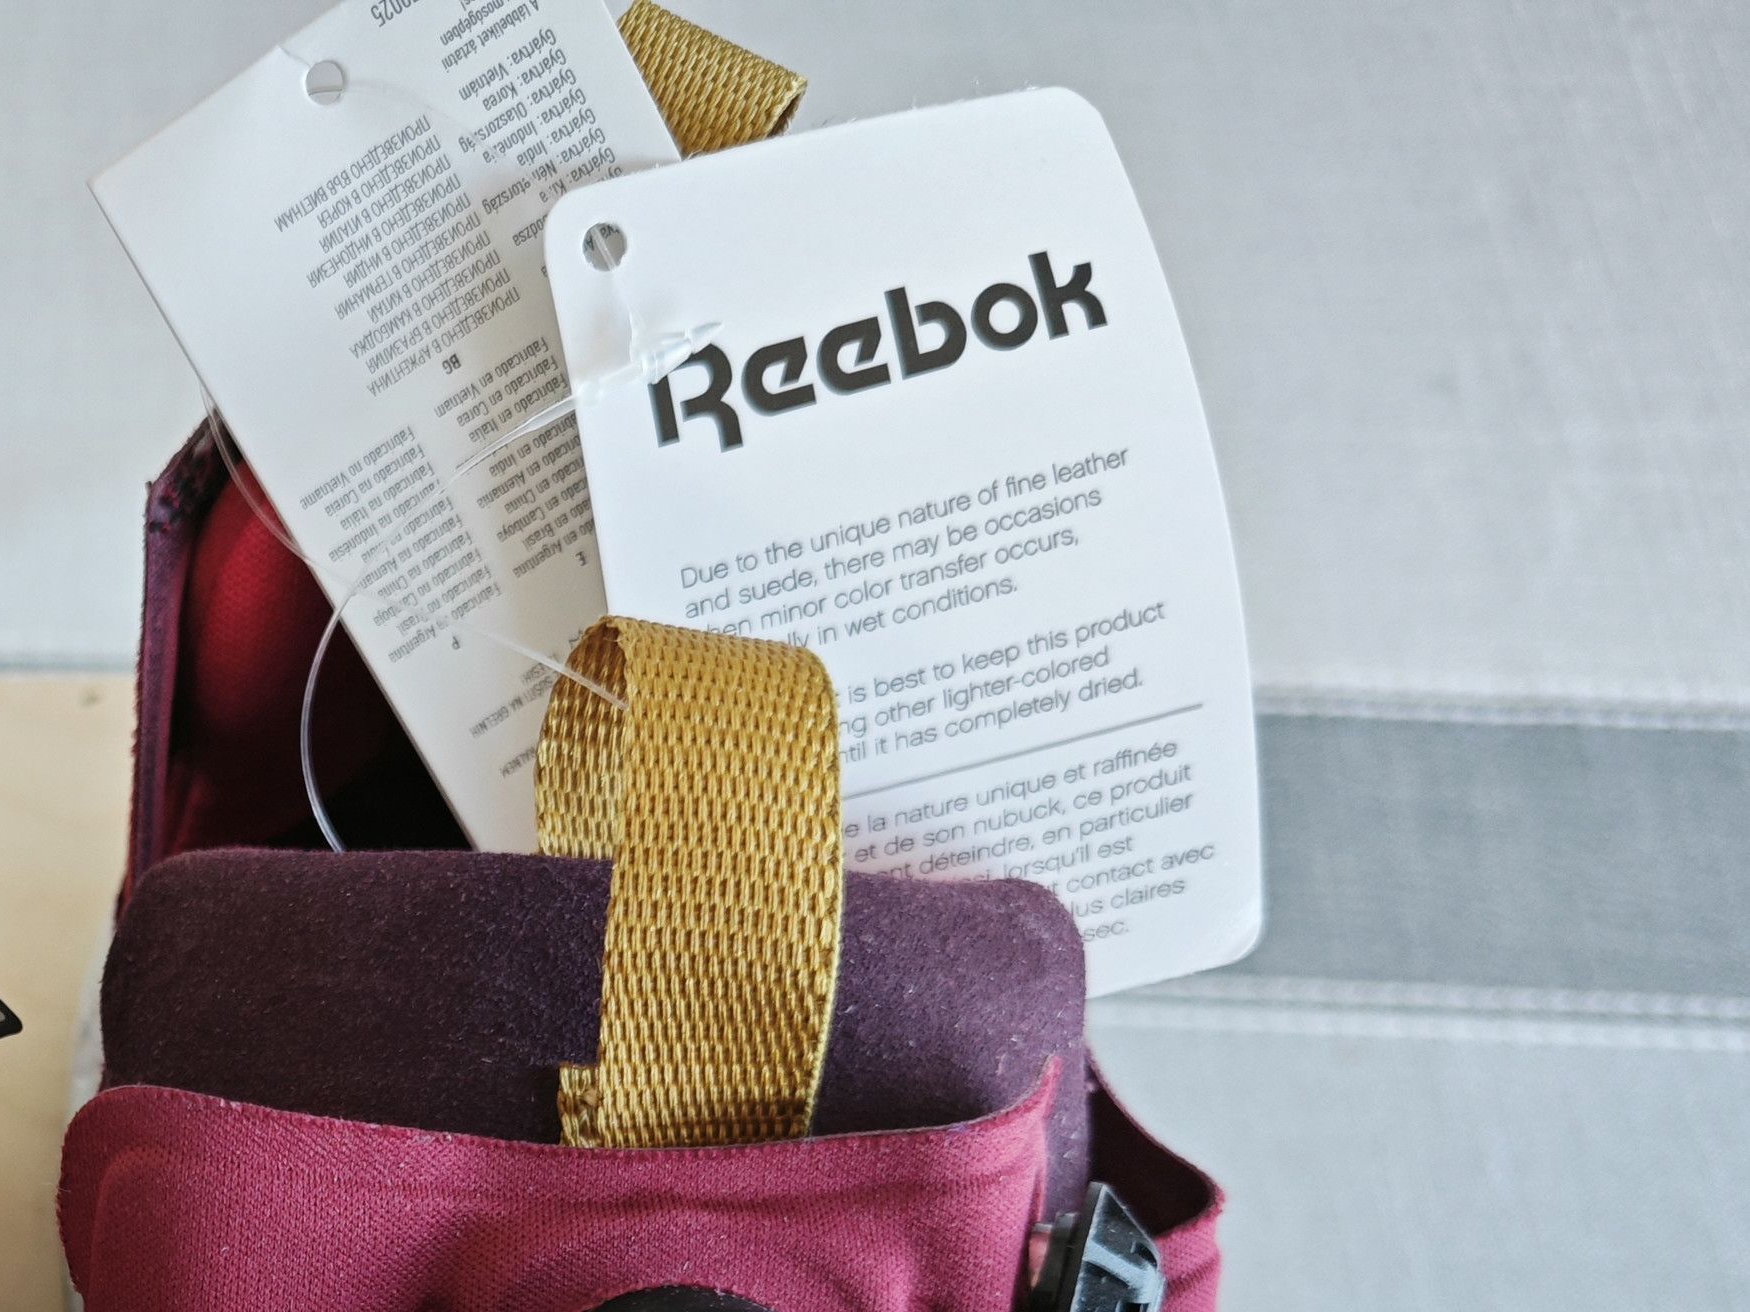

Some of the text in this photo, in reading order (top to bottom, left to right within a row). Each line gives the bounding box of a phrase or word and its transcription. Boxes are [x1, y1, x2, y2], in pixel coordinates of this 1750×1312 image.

[476, 3, 531, 46] lábbeliket
[441, 38, 477, 72] áztatni
[458, 28, 556, 100] Gyártva: Vietnám
[482, 48, 566, 110] Gyártva: Korea
[526, 68, 576, 105] Gyártva:
[536, 87, 586, 124] Gyártva:
[516, 107, 596, 166] Gyártva: India
[556, 127, 605, 163] Gyártva:
[566, 146, 615, 183] Gyártva:
[441, 352, 461, 374] BG
[494, 337, 548, 377] Fabricado
[648, 250, 1108, 453] Reebok
[504, 355, 558, 395] Fabricado
[513, 372, 570, 412] Fabricado
[433, 383, 480, 417] Vietnam
[456, 400, 489, 426] Corea
[468, 417, 499, 442] Italia
[532, 411, 578, 448] abricado
[488, 453, 517, 476] India
[476, 470, 525, 508] Alemania
[503, 488, 536, 514] China
[496, 505, 545, 541] Camboya
[522, 522, 555, 549] Brasil
[680, 449, 1127, 588] Due to the unique nature of fine leather
[512, 538, 562, 577] Argentina
[685, 489, 1101, 618] and suede, there may be occasions
[760, 528, 1078, 628] minor color transfer occurs,
[816, 625, 837, 645] in
[844, 610, 885, 636] wet
[892, 577, 1016, 623] conditions.
[846, 602, 1164, 704] is best to keep this product
[874, 646, 1109, 726] other lighter-colored
[835, 740, 866, 762] ntil
[873, 737, 888, 755] it
[894, 726, 938, 750] has
[944, 690, 1070, 737] completely
[1077, 667, 1142, 701] dried.
[866, 741, 1177, 833] la nature unique et raffinée
[854, 764, 1191, 863] et de son nubuck, ce produit
[919, 793, 1192, 874] déteindre, en particulier
[1096, 835, 1133, 858] est
[1068, 857, 1153, 892] contact
[1160, 844, 1214, 870] avec
[1069, 879, 1185, 922] lus claires
